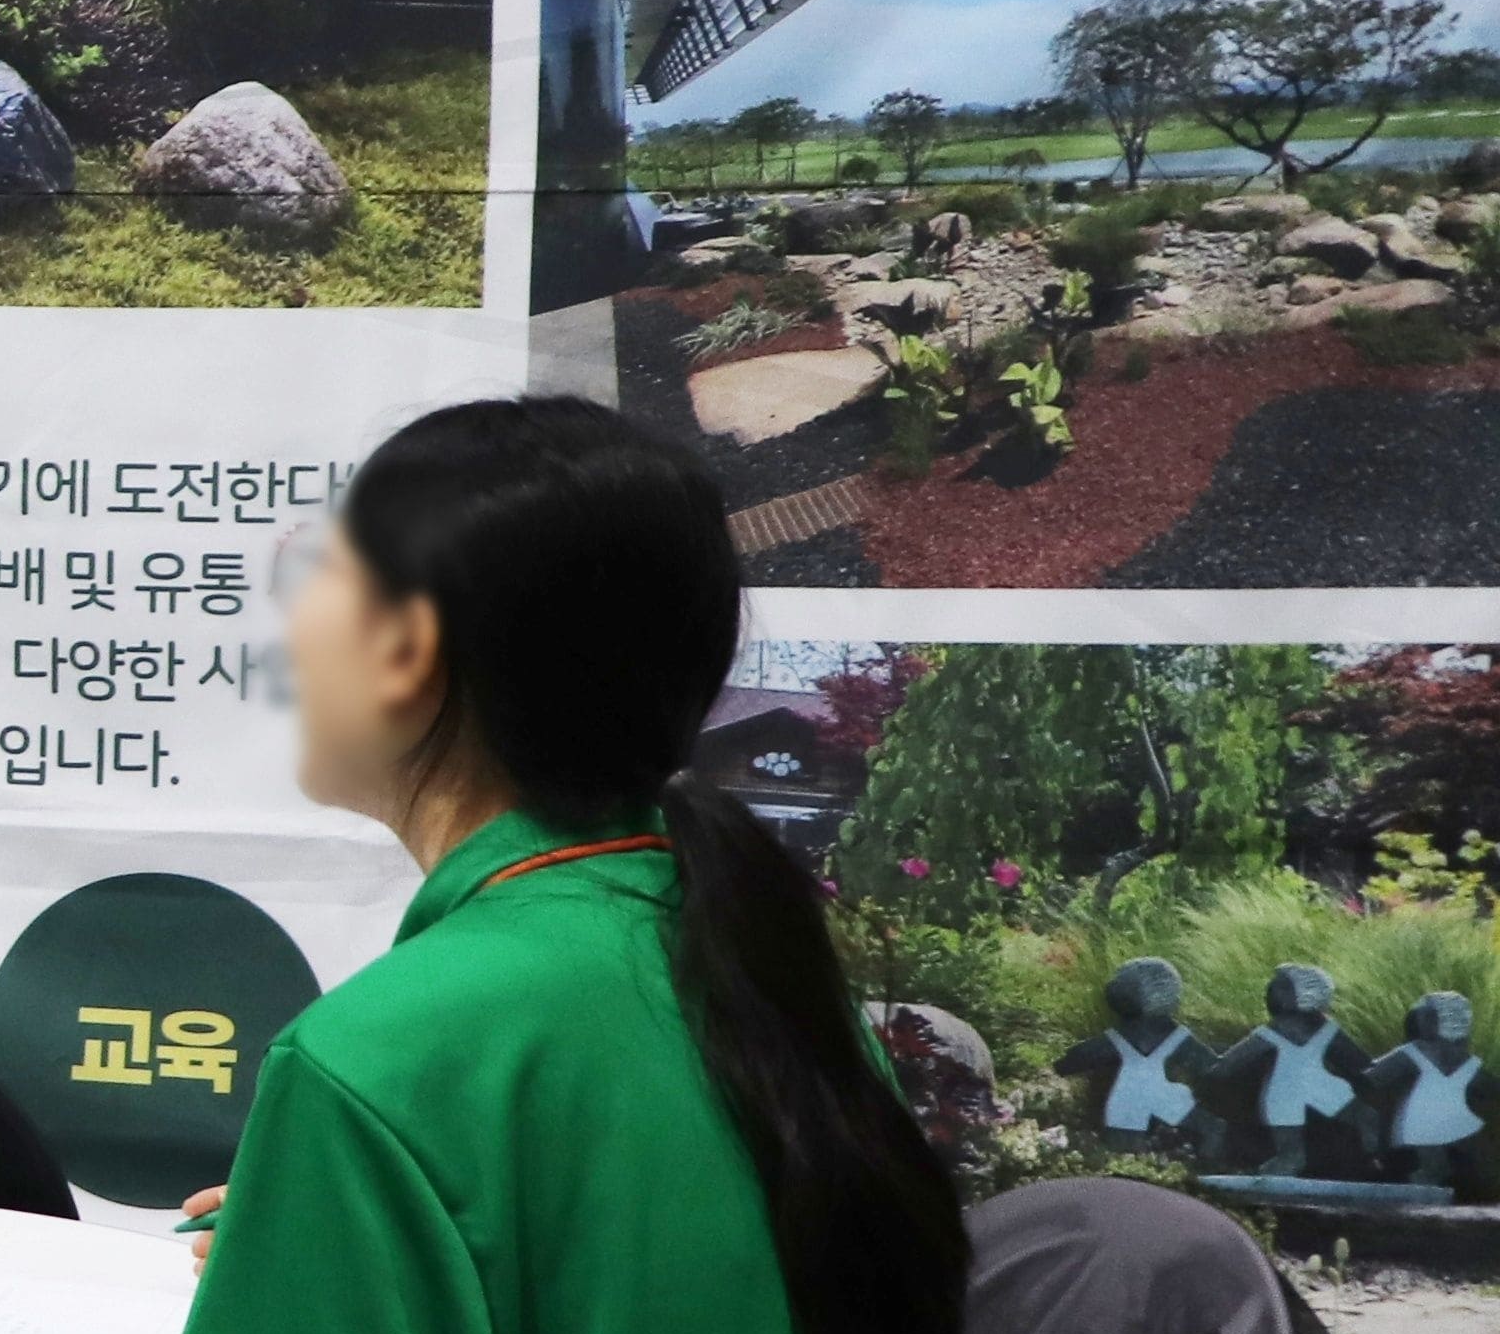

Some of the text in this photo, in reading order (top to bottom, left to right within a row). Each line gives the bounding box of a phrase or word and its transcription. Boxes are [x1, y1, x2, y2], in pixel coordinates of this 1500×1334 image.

[65, 549, 116, 614] 및
[133, 551, 252, 617] 유통
[13, 634, 186, 703] 다양한
[69, 1005, 237, 1094] 교육
